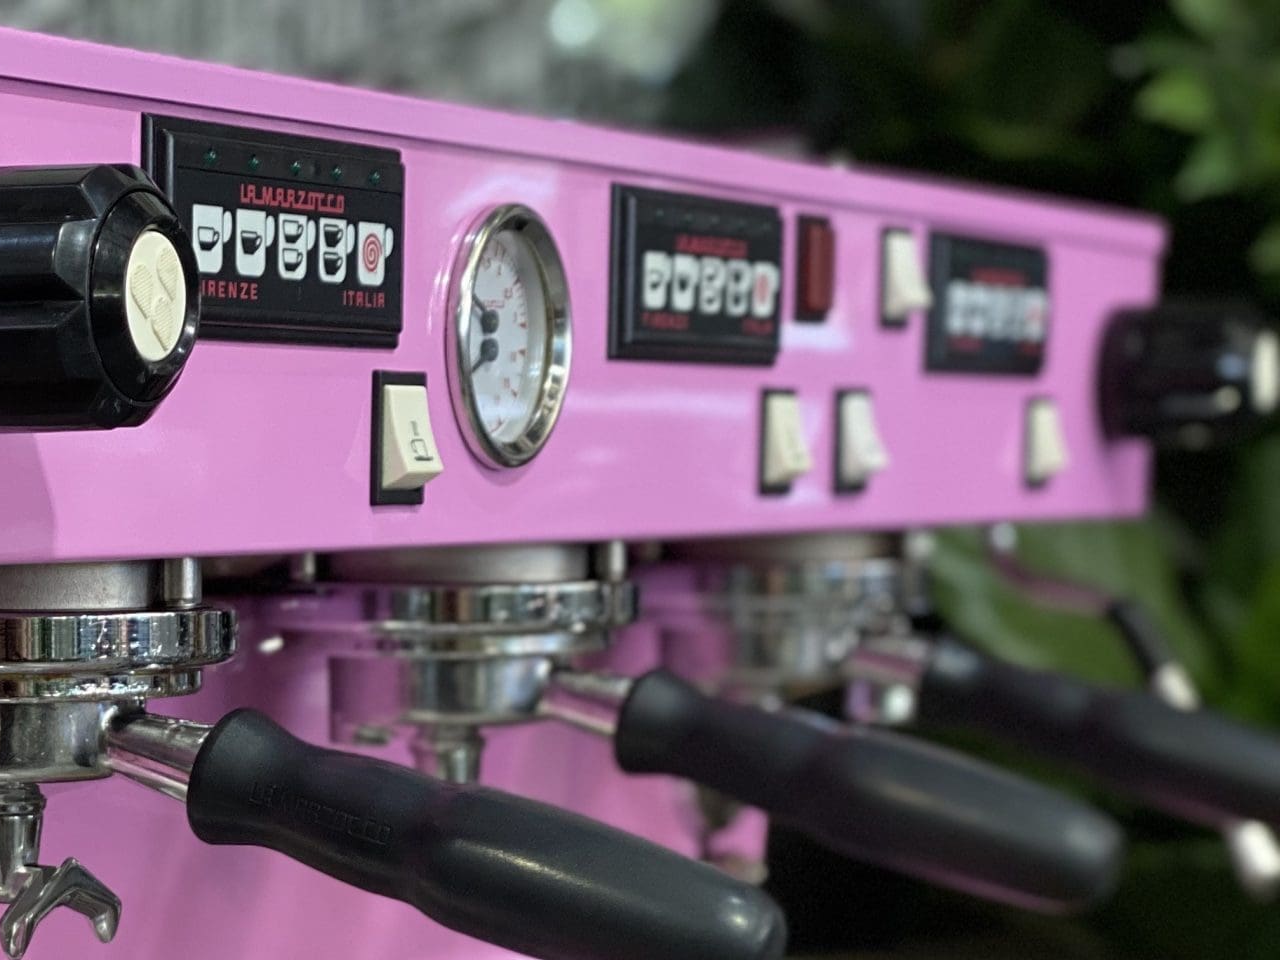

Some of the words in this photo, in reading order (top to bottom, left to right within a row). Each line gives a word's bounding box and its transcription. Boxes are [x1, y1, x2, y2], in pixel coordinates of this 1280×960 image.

[240, 183, 256, 204] LA
[262, 186, 345, 214] MARZOCCO
[201, 279, 258, 300] IRENZE
[343, 290, 385, 308] ITALIA
